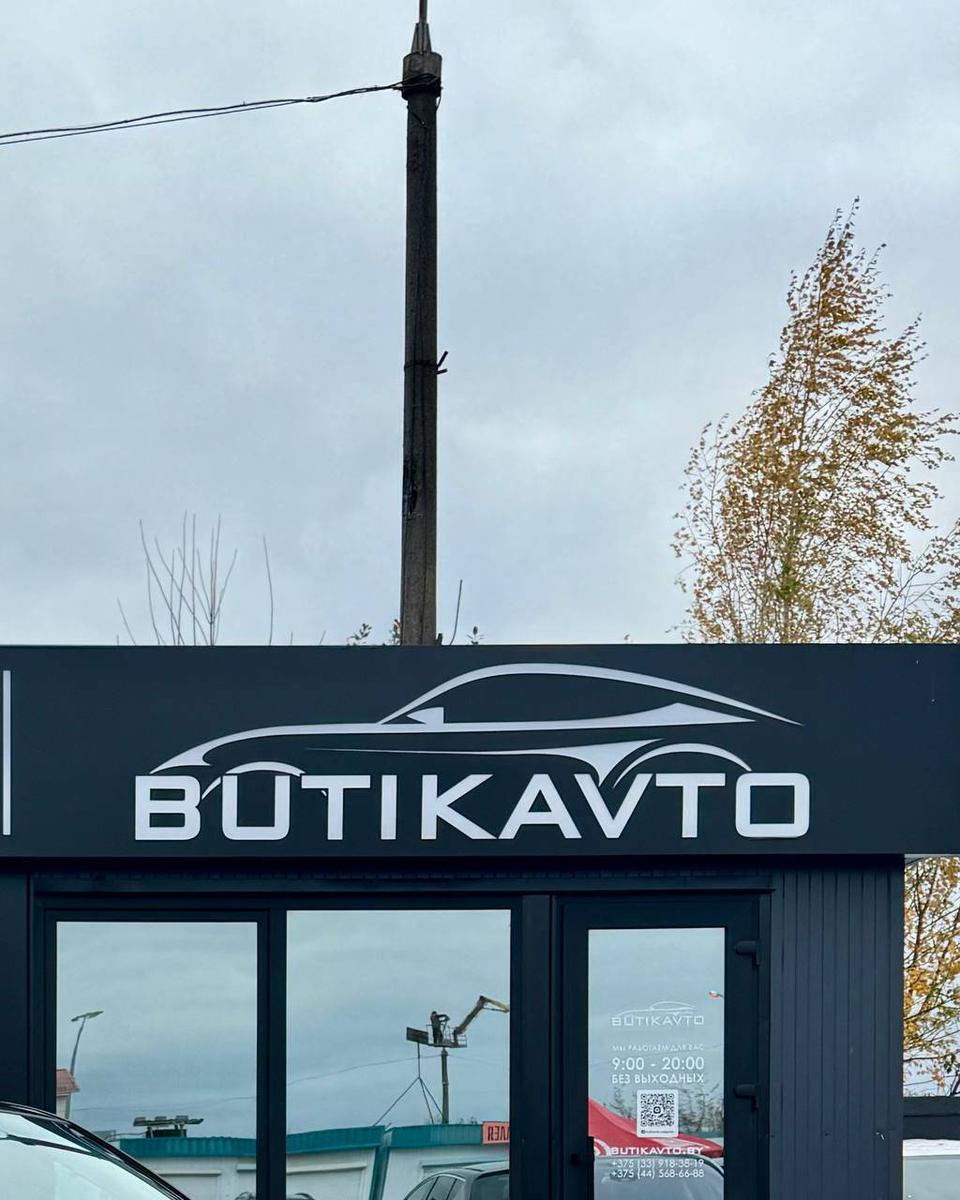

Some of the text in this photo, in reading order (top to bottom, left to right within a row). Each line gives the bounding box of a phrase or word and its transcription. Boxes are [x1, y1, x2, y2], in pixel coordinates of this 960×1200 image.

[135, 772, 810, 842] BUTIKAVTO
[612, 1015, 704, 1026] BUTIKAVTO
[612, 1057, 645, 1071] 9:00
[662, 1057, 705, 1071] 20:00
[612, 1073, 704, 1085] БЕЗ ВЫХОДНЫХ
[611, 1147, 704, 1155] BUTIKAVTO.BY
[612, 1159, 635, 1168] +375
[637, 1159, 655, 1169] (33)
[612, 1169, 705, 1180] +375 (44) 568-66-88
